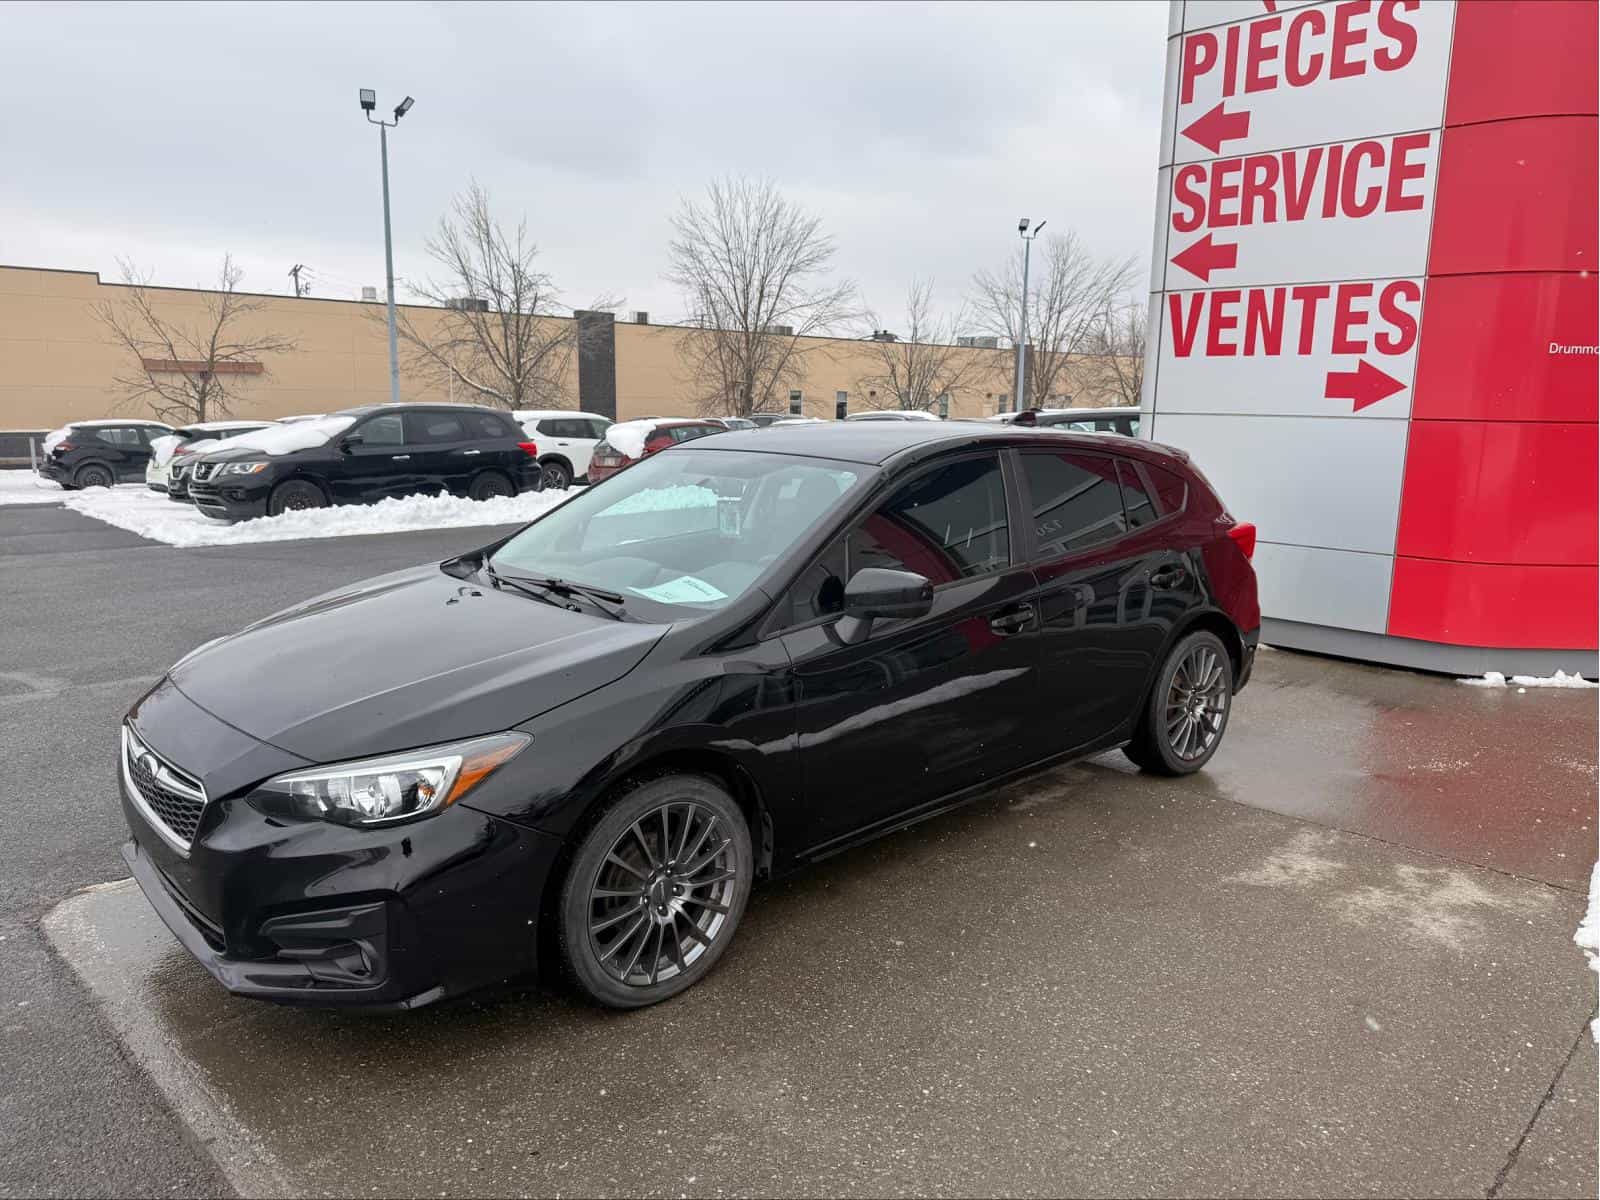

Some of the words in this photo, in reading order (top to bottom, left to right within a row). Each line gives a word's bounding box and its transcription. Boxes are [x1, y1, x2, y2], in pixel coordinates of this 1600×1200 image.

[1180, 0, 1421, 104] PIÈCES
[1172, 133, 1430, 232] SERVICE
[1168, 280, 1421, 358] VENTES
